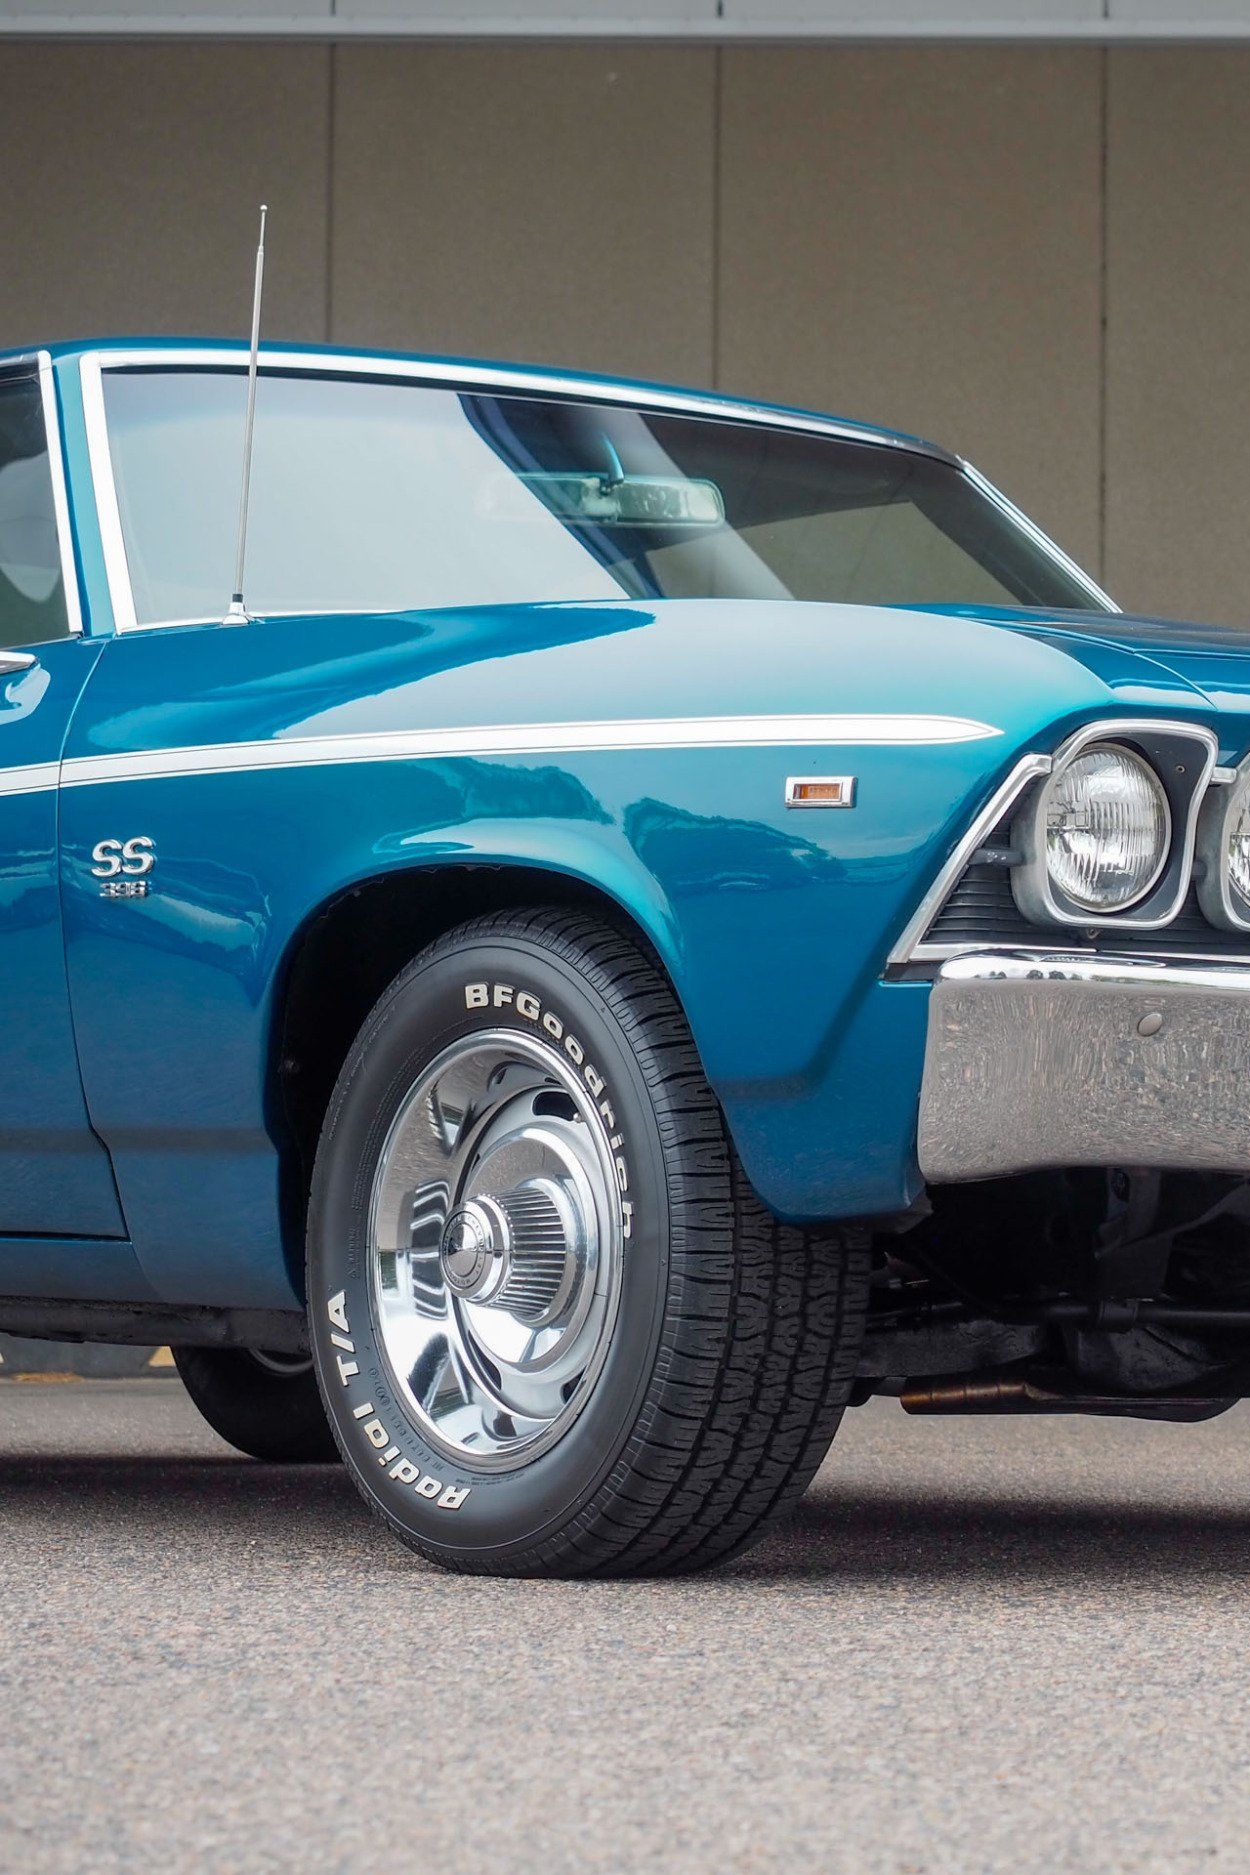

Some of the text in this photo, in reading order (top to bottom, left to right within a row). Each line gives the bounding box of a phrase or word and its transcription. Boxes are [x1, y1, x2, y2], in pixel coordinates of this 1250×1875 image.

[91, 836, 154, 877] SS
[465, 982, 633, 1239] BFGoodrich
[328, 1289, 361, 1388] T/A
[353, 1402, 471, 1509] Radial
